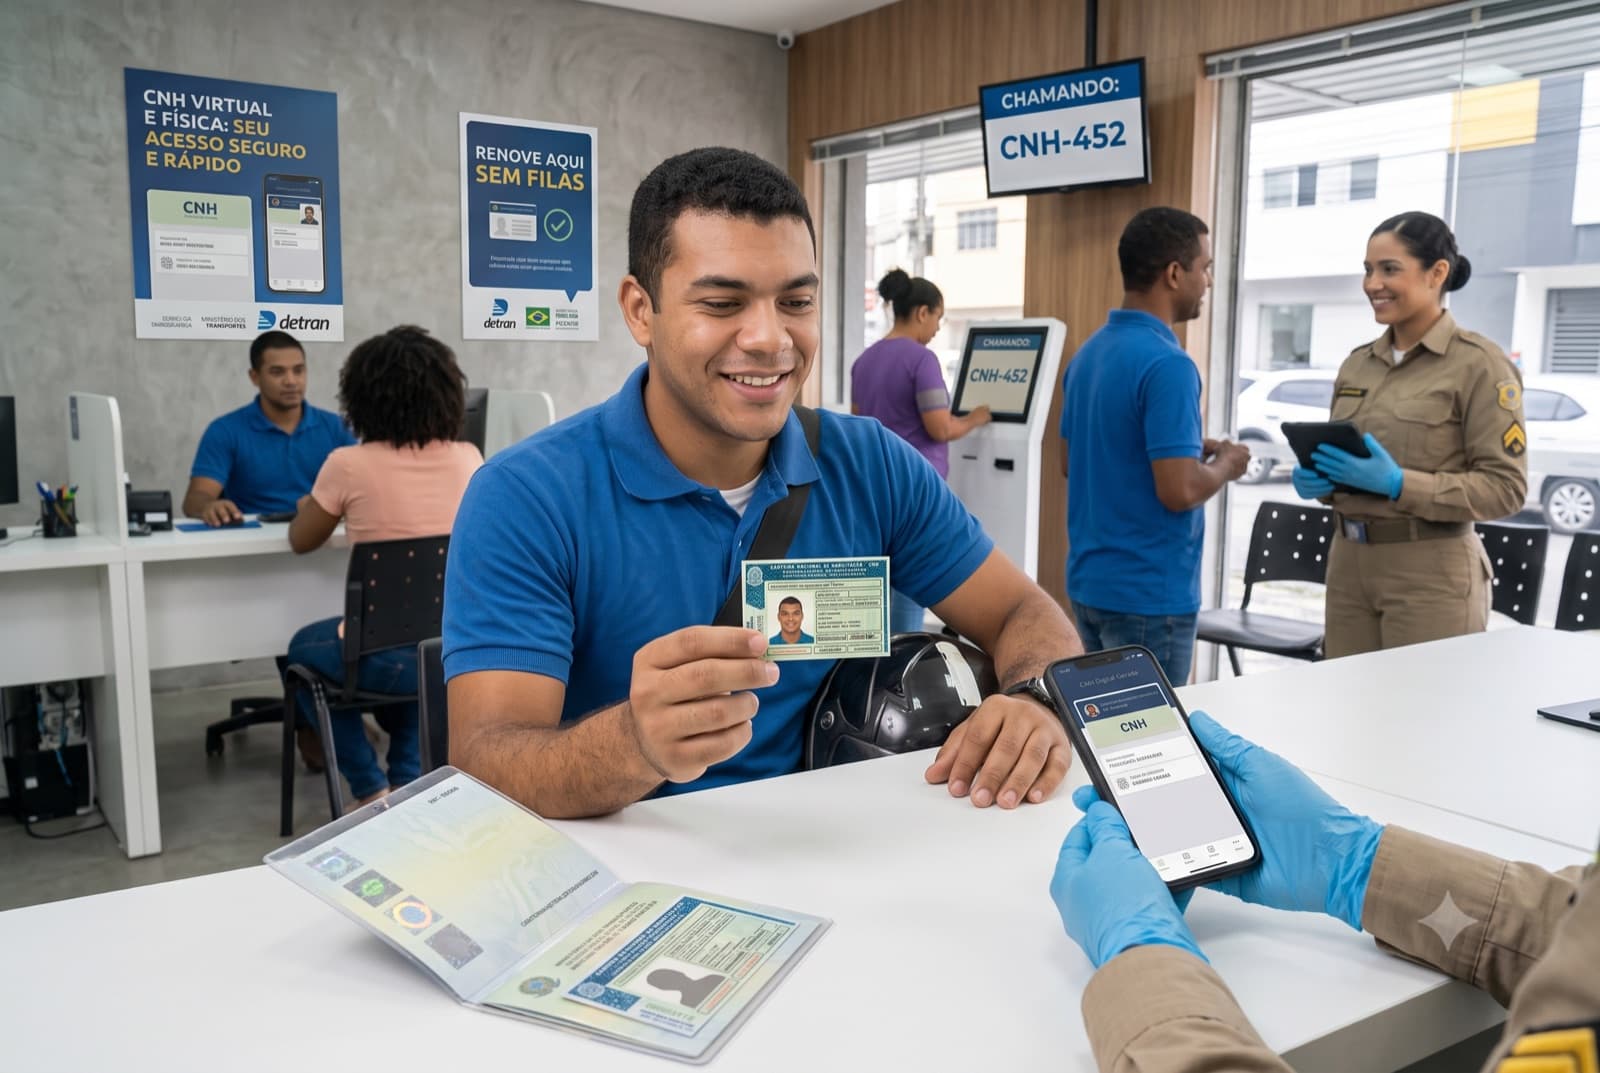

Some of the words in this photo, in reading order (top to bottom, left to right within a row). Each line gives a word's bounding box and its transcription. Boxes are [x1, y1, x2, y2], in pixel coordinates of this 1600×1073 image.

[143, 89, 186, 108] CNH
[190, 95, 273, 118] VIRTUAL
[1001, 76, 1120, 110] CHAMANDO:
[144, 110, 156, 125] E
[162, 109, 229, 132] FÍSICA:
[233, 119, 270, 136] SEU
[144, 131, 225, 152] ACESSO
[229, 139, 307, 160] SEGURO
[1000, 120, 1127, 160] CNH-452
[146, 151, 158, 166] E
[164, 150, 241, 173] RÁPIDO
[475, 145, 541, 165] RENOVE
[545, 153, 584, 170] AQUI
[476, 165, 521, 186] SEM
[527, 169, 585, 191] FILAS
[183, 201, 218, 215] CNH
[206, 322, 247, 330] TRANSPORTES
[279, 314, 330, 331] detran
[483, 317, 517, 329] detran
[982, 337, 1032, 348] CHAMANDO:
[969, 368, 1029, 384] CNH-452
[1120, 718, 1148, 733] CNH
